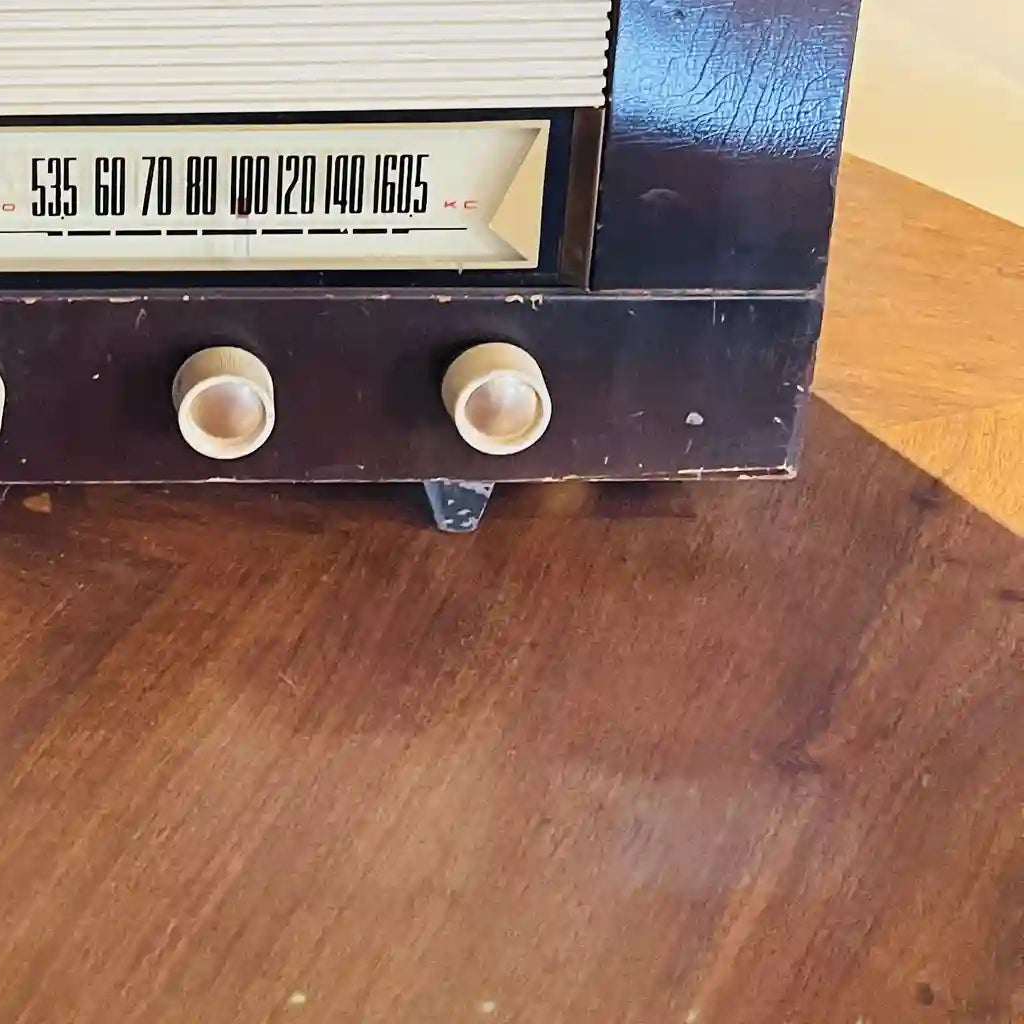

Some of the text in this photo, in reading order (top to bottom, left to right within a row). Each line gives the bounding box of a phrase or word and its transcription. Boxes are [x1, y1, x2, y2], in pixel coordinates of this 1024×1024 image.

[94, 156, 126, 216] 60
[141, 156, 173, 216] 70
[185, 155, 218, 216] 80
[230, 155, 270, 216] 100
[276, 154, 317, 215] 120
[325, 154, 366, 215] 140
